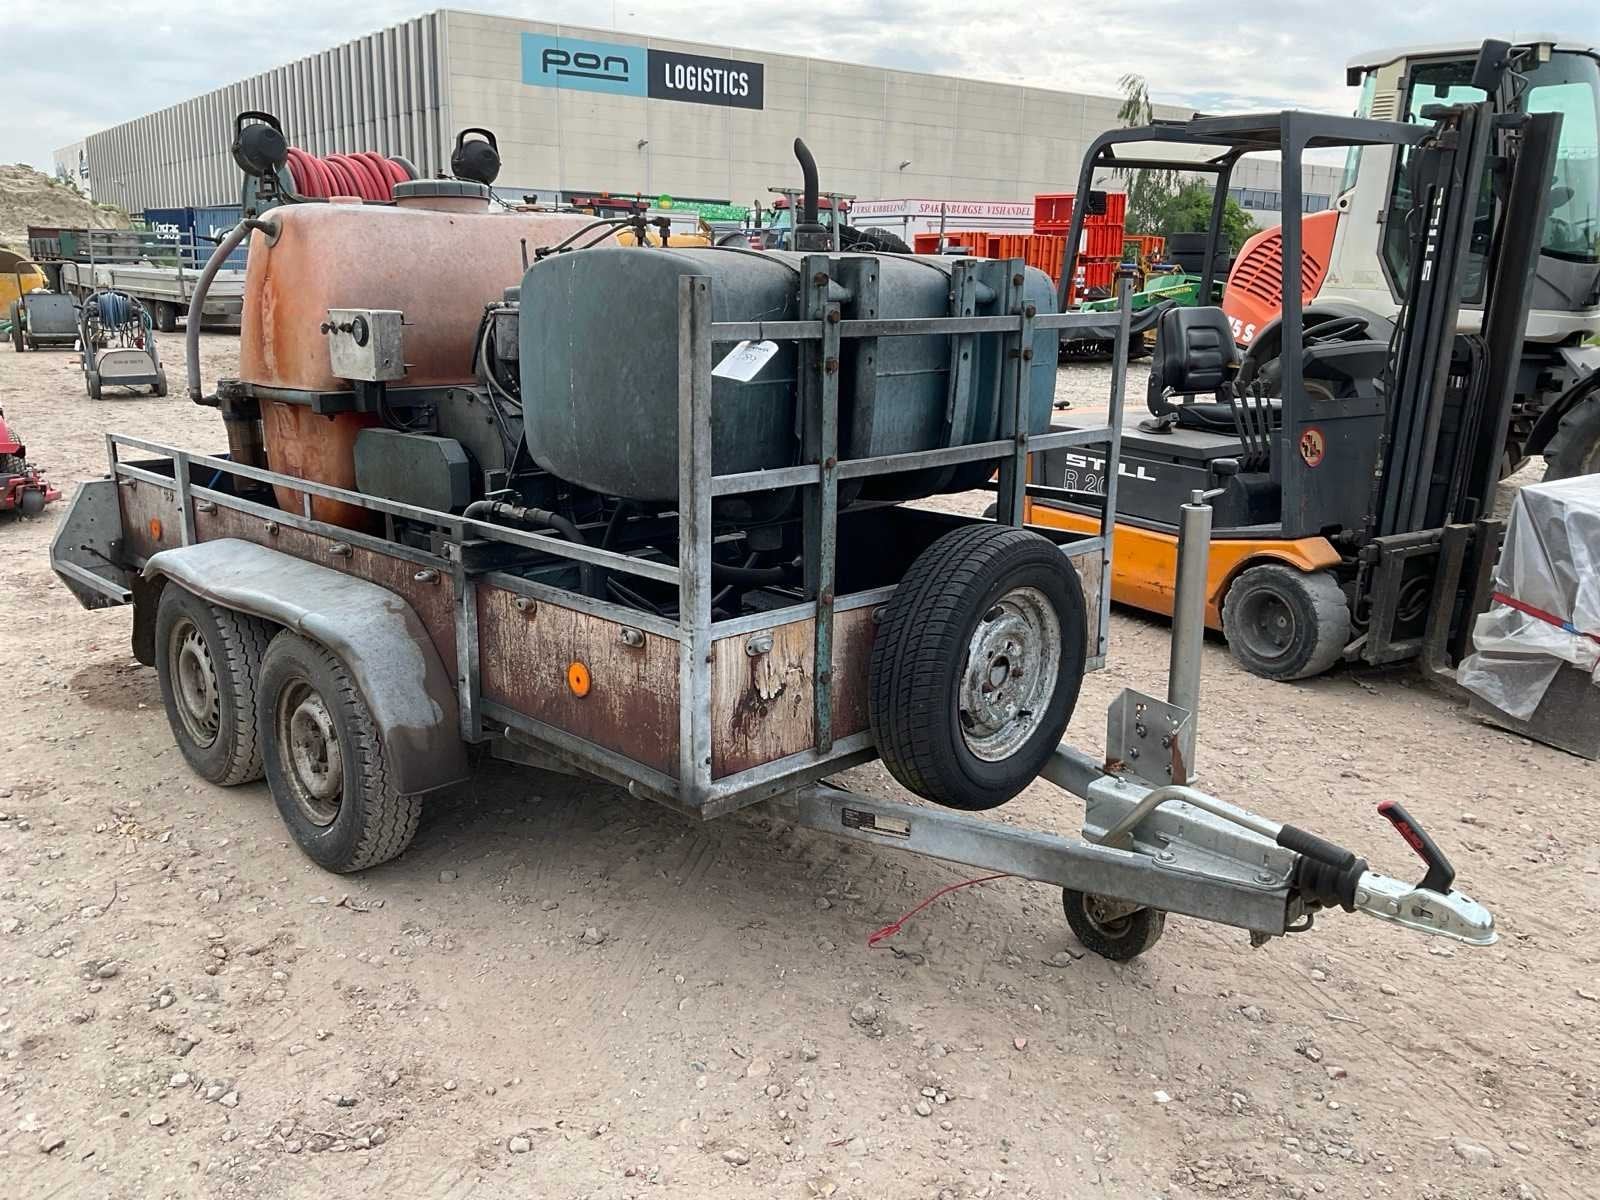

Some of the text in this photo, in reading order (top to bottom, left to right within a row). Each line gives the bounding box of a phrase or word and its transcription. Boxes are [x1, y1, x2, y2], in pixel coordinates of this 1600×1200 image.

[665, 63, 749, 97] LOGISTICS
[918, 203, 1032, 216] SPAKNBURGSE VISHANDEL
[1421, 187, 1444, 281] STILL
[1063, 468, 1079, 491] R
[1065, 453, 1157, 482] STLL
